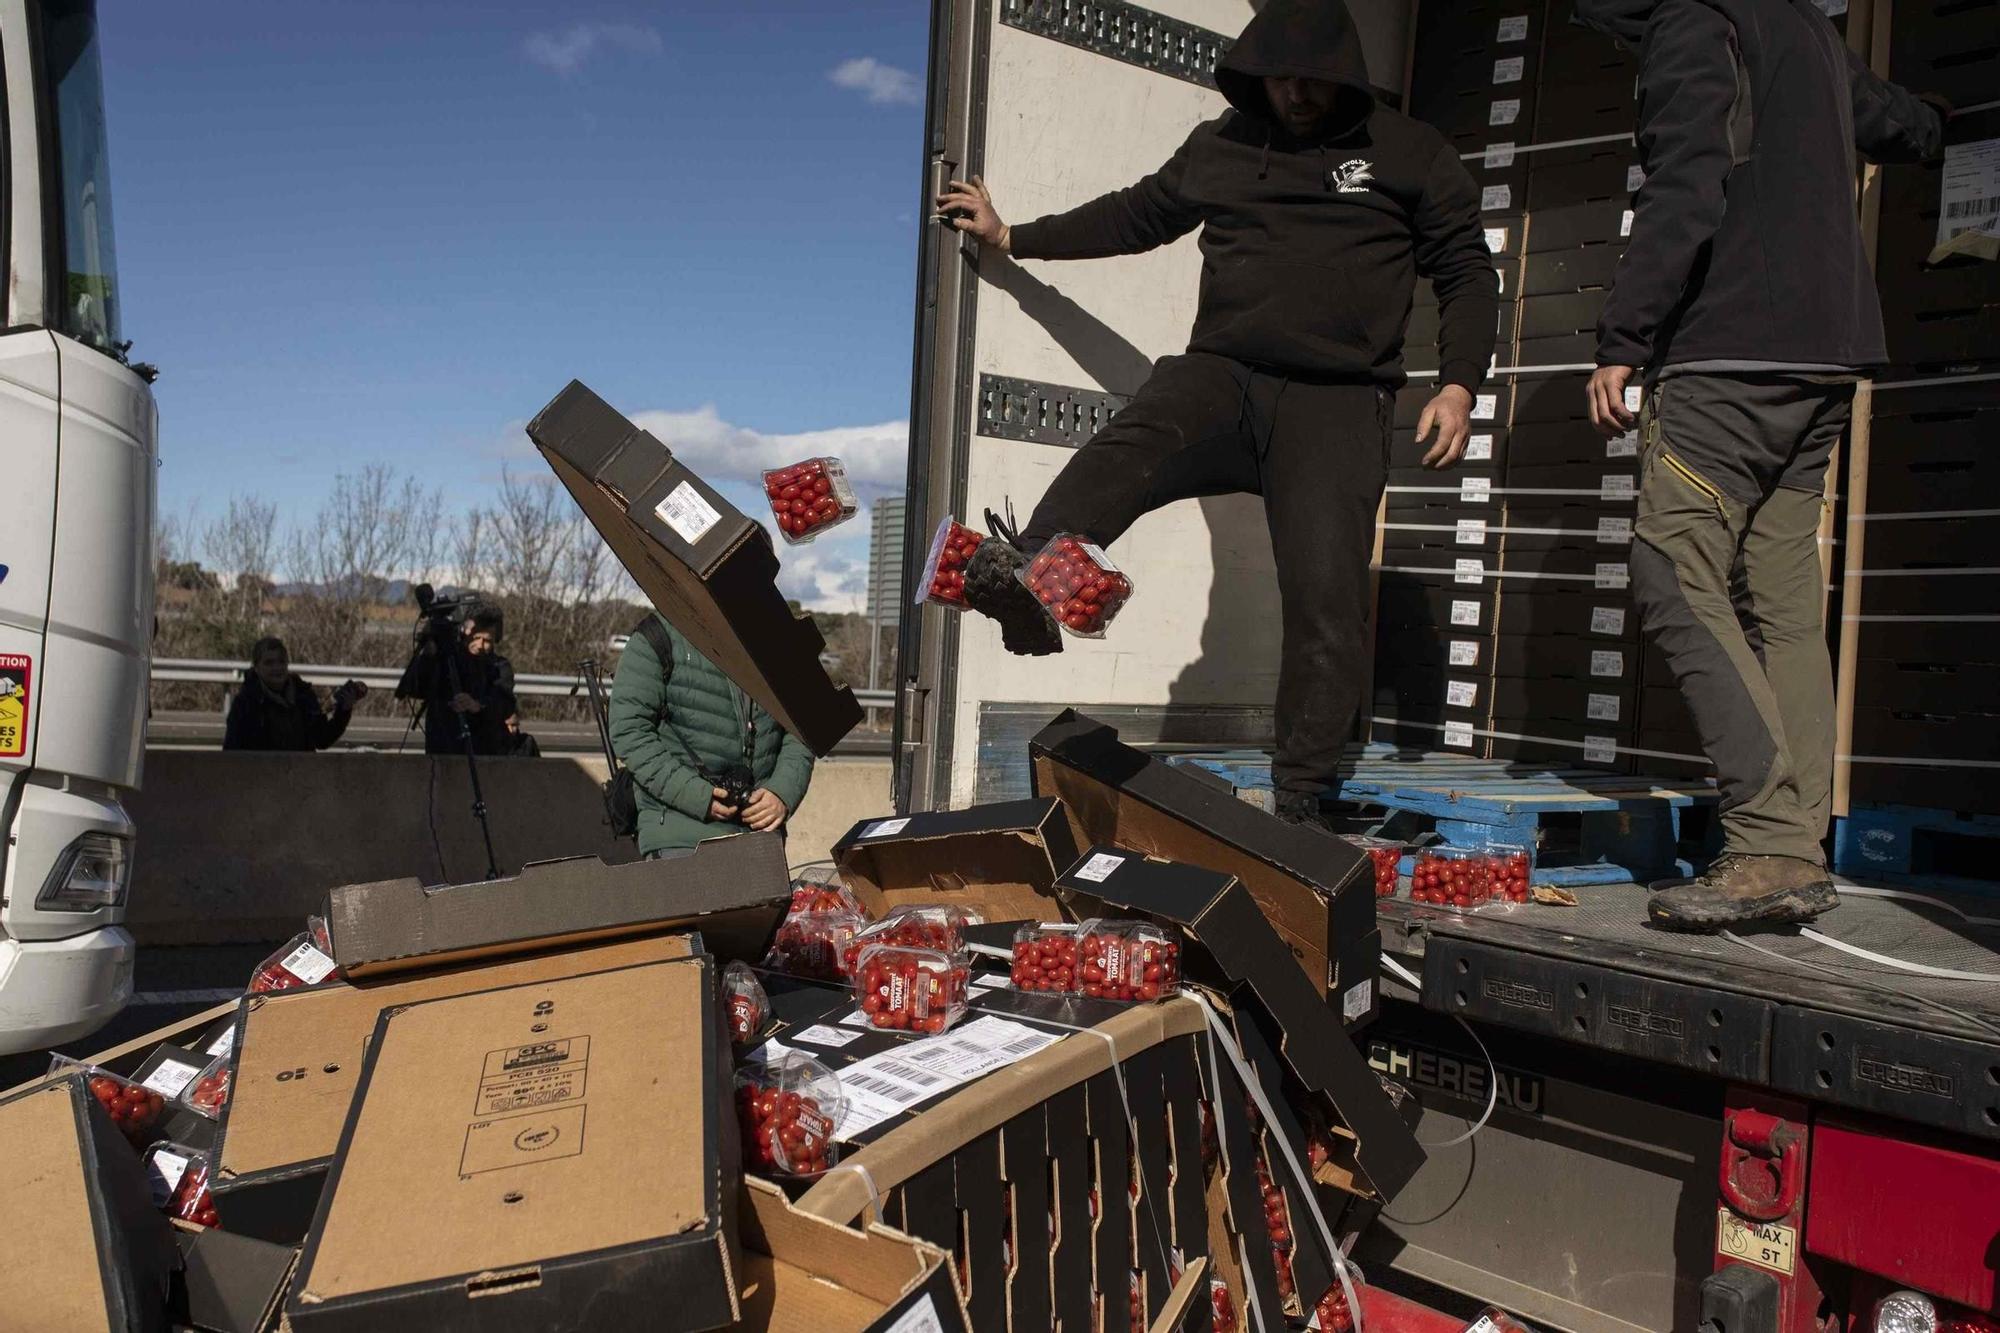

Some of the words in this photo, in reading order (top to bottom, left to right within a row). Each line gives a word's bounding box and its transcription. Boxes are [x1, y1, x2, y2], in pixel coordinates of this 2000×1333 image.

[1111, 948, 1120, 979] TOMAAT
[894, 976, 904, 1009] TOMAAT
[1368, 1040, 1539, 1112] CHEREAU
[1860, 1062, 1951, 1094] CHEREAU
[1761, 1248, 1781, 1264] 5T
